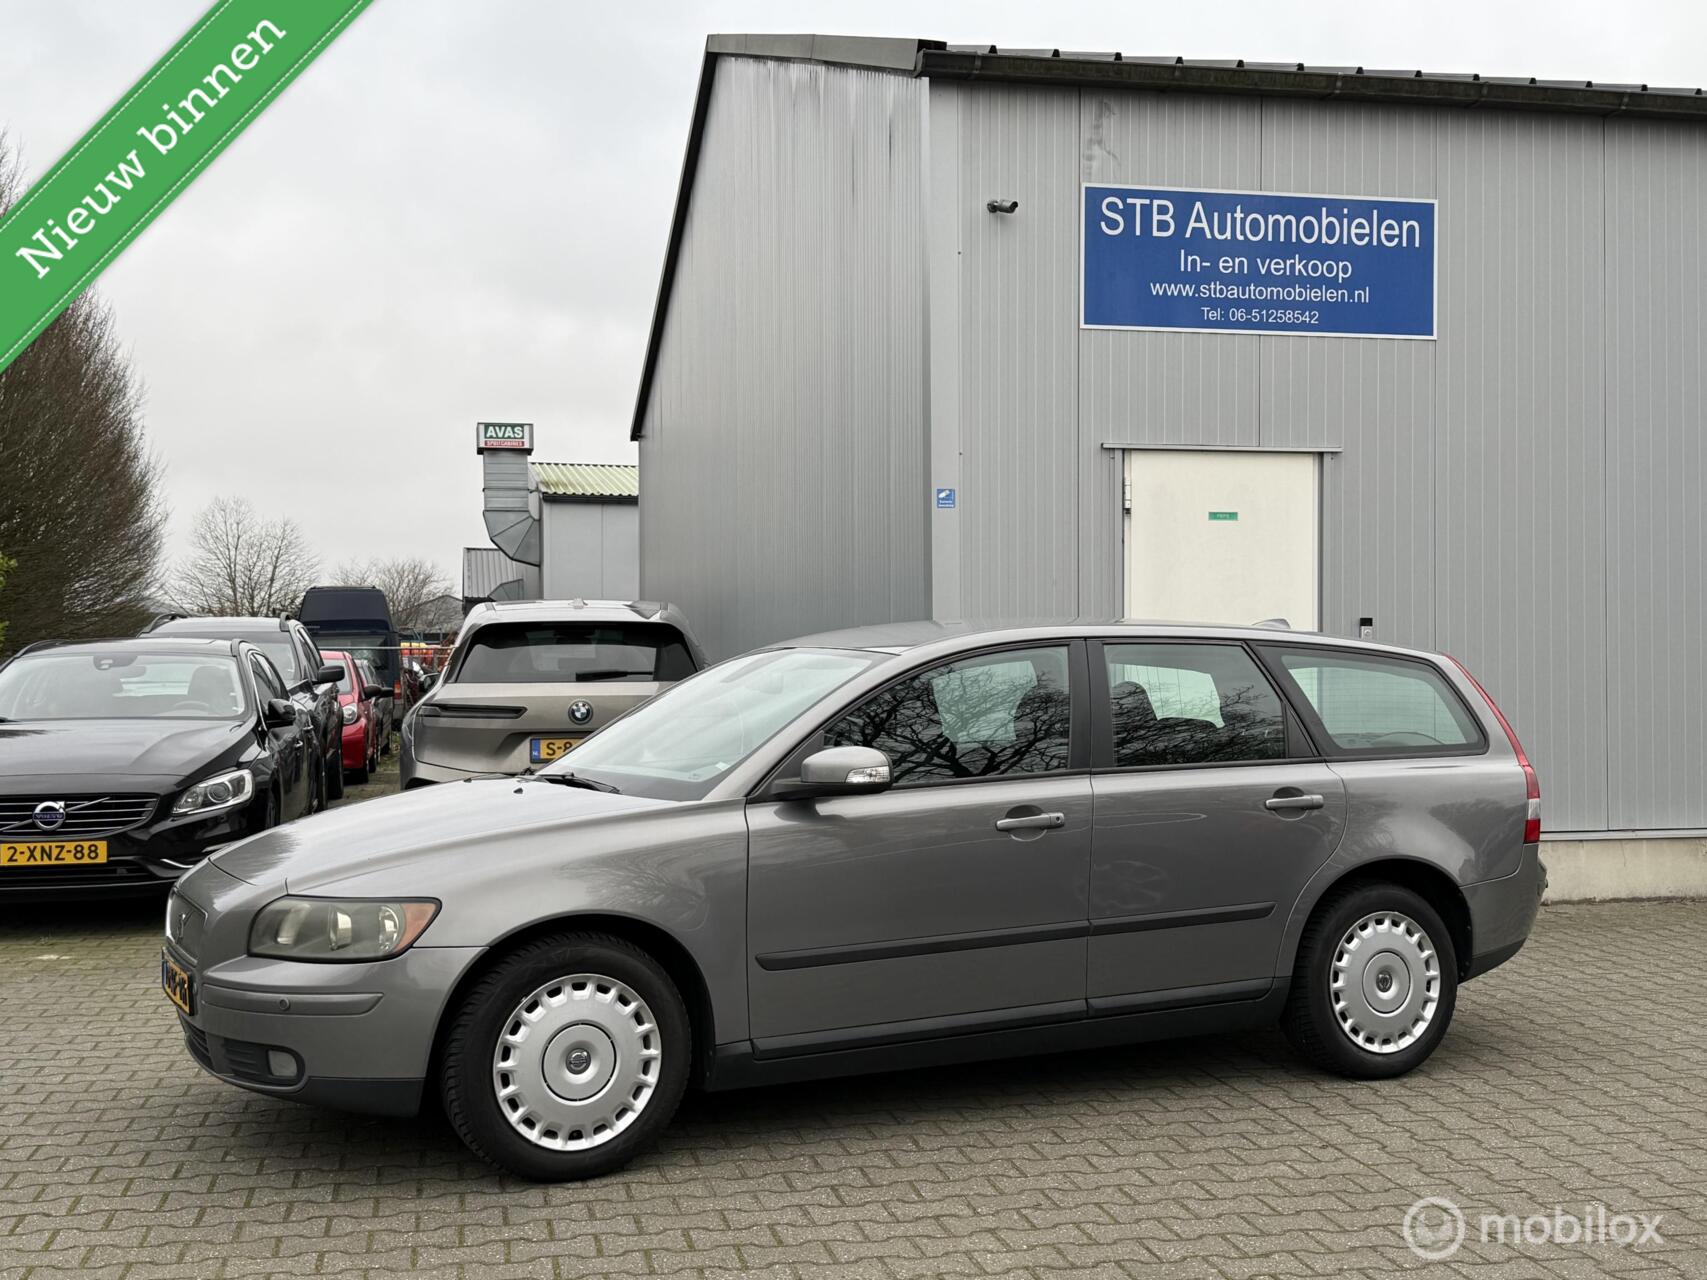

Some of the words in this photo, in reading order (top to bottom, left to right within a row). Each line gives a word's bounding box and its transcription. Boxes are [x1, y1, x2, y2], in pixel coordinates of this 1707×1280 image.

[1100, 196, 1175, 237] STB
[1185, 201, 1420, 248] Automobielen
[1180, 249, 1210, 272] In-
[1219, 257, 1248, 275] en
[1257, 254, 1352, 283] verkoop
[1150, 281, 1369, 303] www.stbautomobielen.nl
[1201, 307, 1225, 321] Tel:
[1229, 308, 1319, 324] 06-51258542
[486, 425, 523, 438] AVAS
[7, 843, 99, 862] 2-XNZ-88
